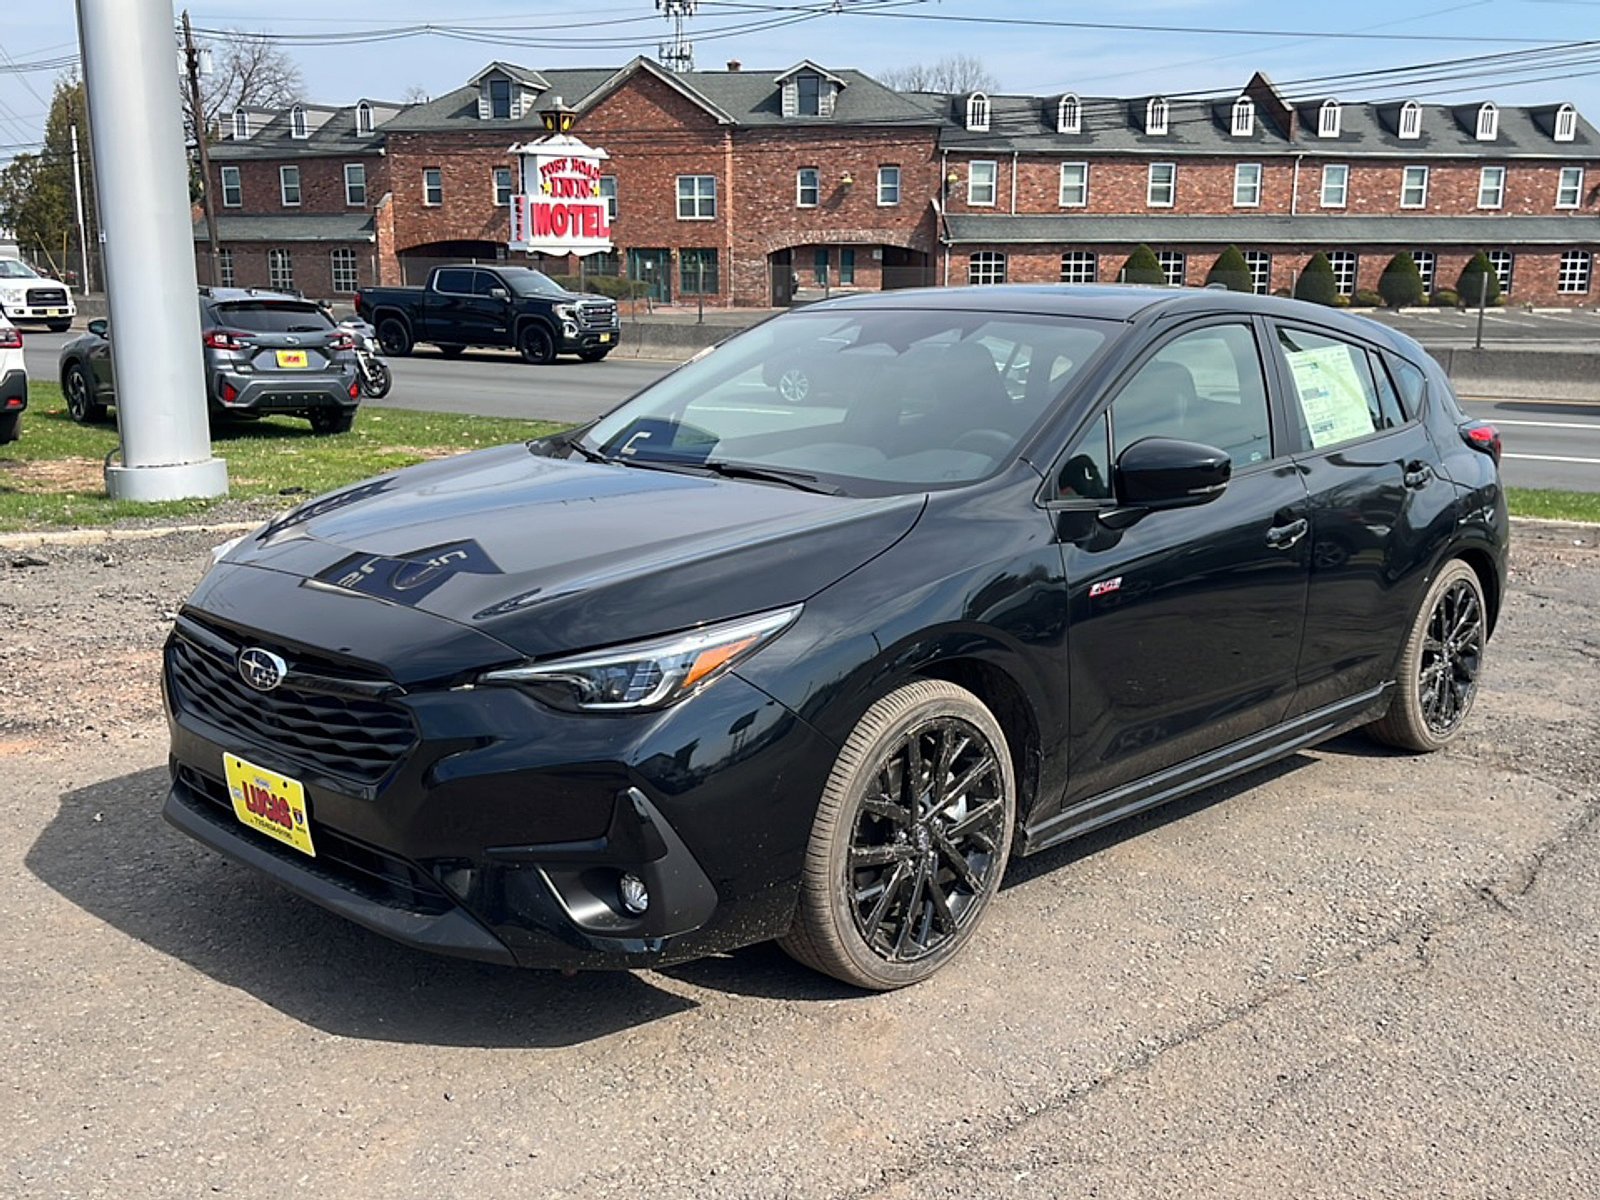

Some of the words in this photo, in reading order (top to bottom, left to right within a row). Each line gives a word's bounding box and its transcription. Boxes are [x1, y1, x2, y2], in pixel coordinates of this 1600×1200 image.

[539, 158, 568, 184] POST
[570, 157, 601, 181] ROAD
[549, 176, 591, 199] INN
[530, 203, 611, 238] MOTEL
[242, 780, 293, 831] LUCAS
